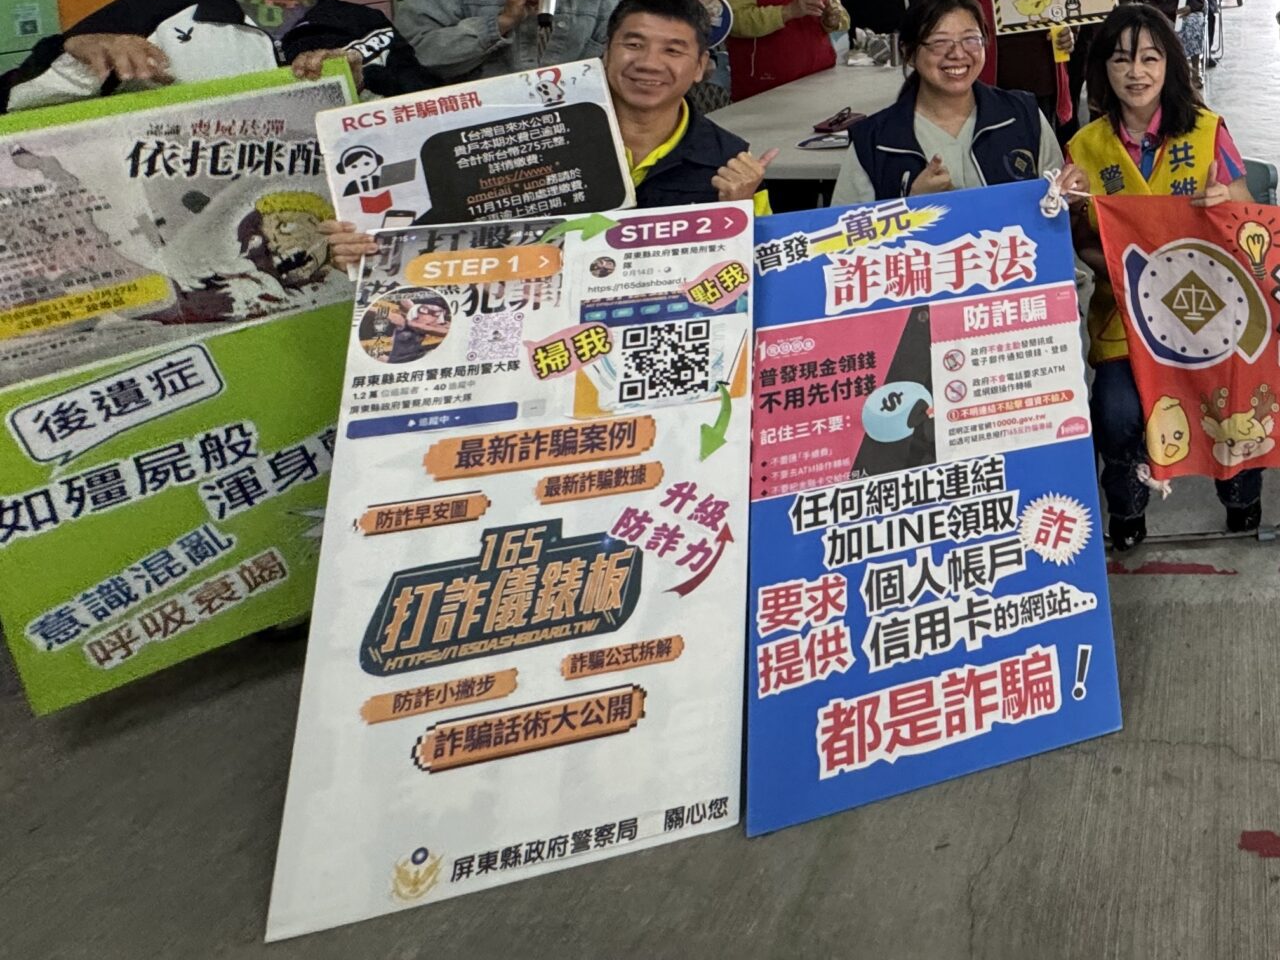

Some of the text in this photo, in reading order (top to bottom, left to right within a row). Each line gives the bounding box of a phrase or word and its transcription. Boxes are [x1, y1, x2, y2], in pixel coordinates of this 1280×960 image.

[341, 91, 483, 133] RCS 詐騙簡訊
[621, 218, 712, 241] STEP 2
[423, 256, 520, 279] STEP 1
[688, 263, 749, 304] 點我
[834, 236, 1035, 307] 詐騙手法
[963, 295, 1048, 332] 防詐騙
[352, 360, 520, 388] 屏東縣政府警察局刑警大隊
[533, 325, 613, 379] 掃我
[759, 351, 877, 388] 普發現金領錢
[34, 357, 205, 443] 後遺症
[759, 374, 877, 414] 不用先付錢
[455, 424, 638, 469] 最新詐騙案例
[543, 464, 647, 498] 最新詐騙數據
[792, 458, 1005, 531] 任何網址連結
[375, 499, 468, 531] 防詐早安圖
[661, 480, 732, 532] 升級
[1034, 506, 1078, 549] 詐
[480, 526, 547, 572] 165
[610, 507, 716, 572] 防詐力
[827, 496, 1016, 566] 加LINE領取
[30, 523, 235, 650] 意識混亂
[864, 539, 1025, 612] 個人帳戶
[760, 575, 846, 632] 要求
[570, 639, 673, 673] 詐騙公式拆解
[759, 626, 849, 694] 提供
[432, 694, 632, 759] 詐騙話術大公開
[450, 796, 730, 883] 屏東縣政府警察局 關心您
